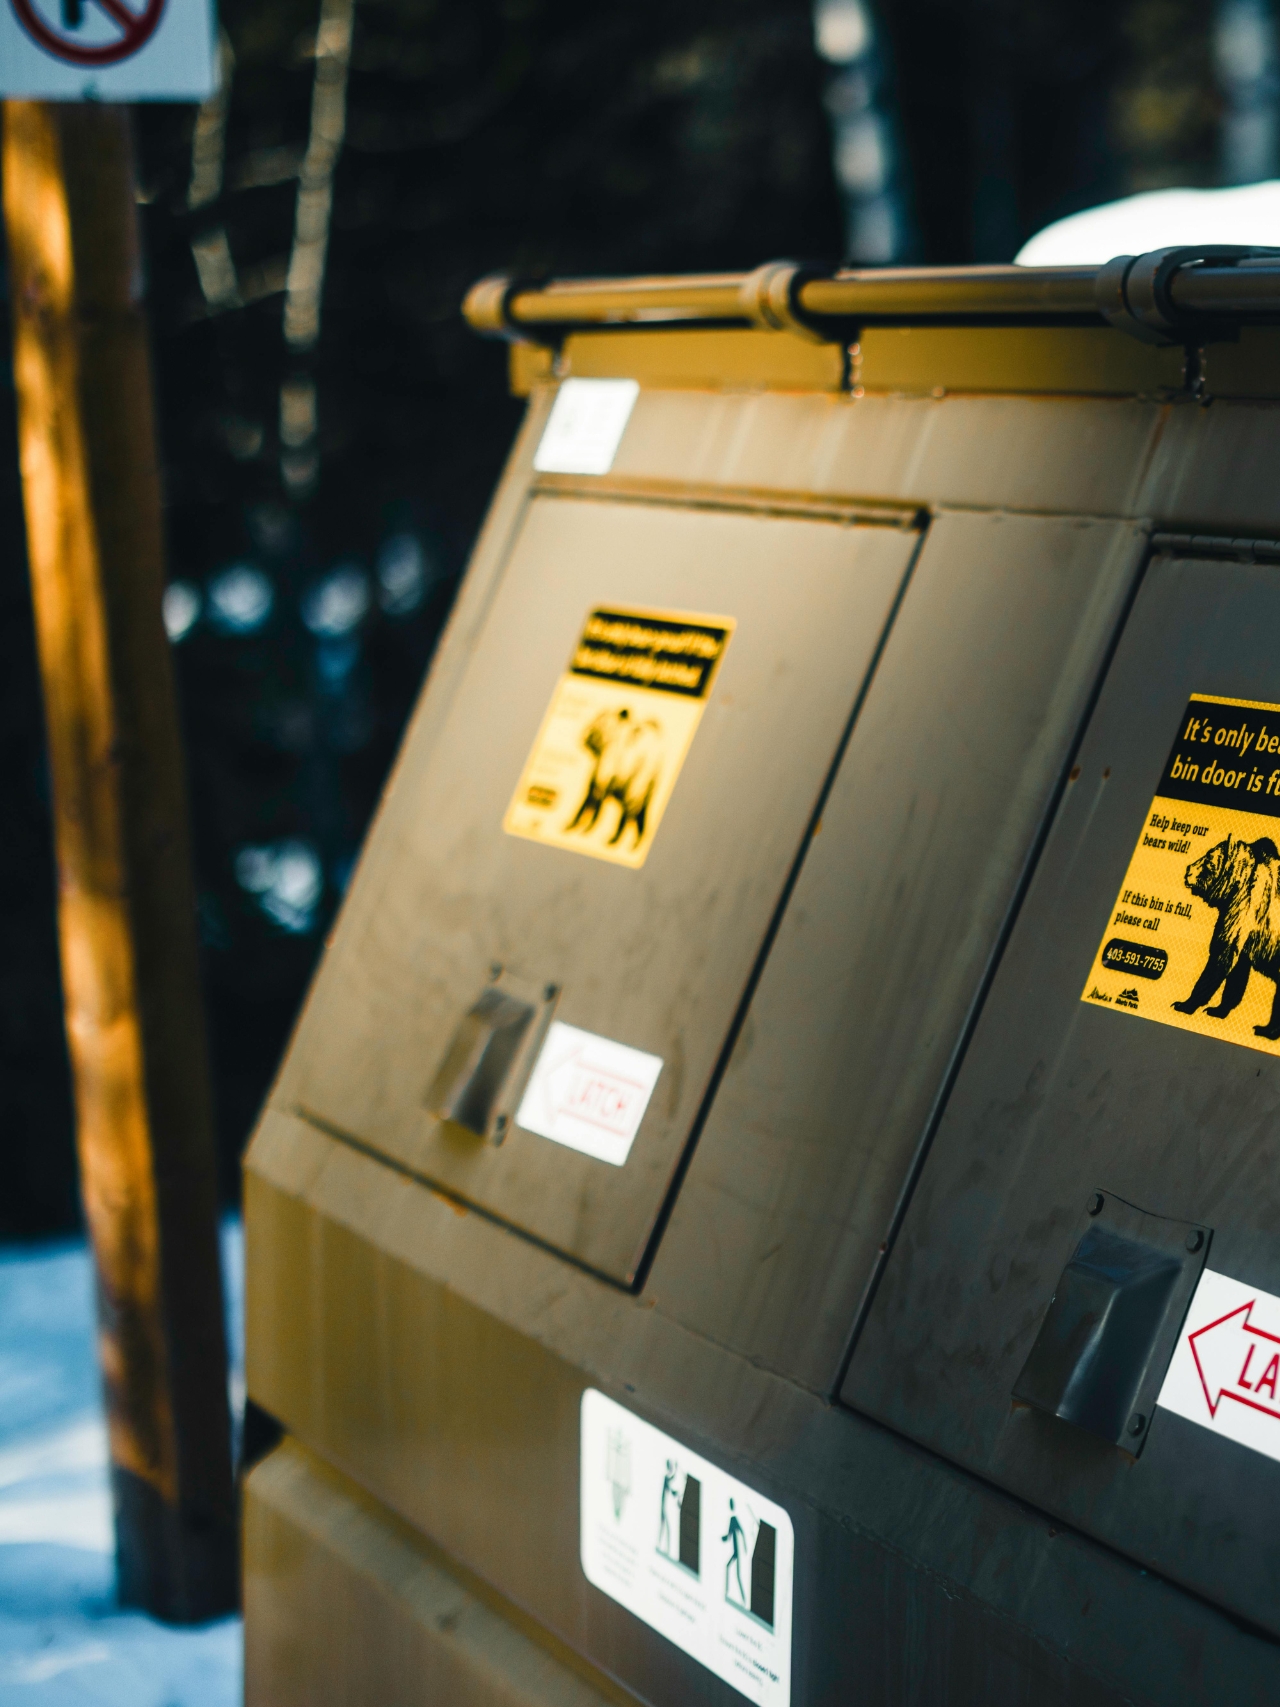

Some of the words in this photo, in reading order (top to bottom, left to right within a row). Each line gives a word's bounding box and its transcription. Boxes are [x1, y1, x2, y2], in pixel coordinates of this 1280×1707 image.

[1183, 717, 1212, 743] It's
[1214, 725, 1254, 757] only
[1170, 754, 1200, 782] bin
[1201, 759, 1246, 789] door
[1246, 766, 1264, 793] is
[1149, 814, 1170, 831] Help
[1170, 818, 1193, 837] keep
[1192, 825, 1210, 837] our
[1142, 833, 1167, 850] bears
[1167, 838, 1191, 854] wild!
[1121, 890, 1134, 904] If
[1128, 892, 1149, 908] this
[1149, 896, 1165, 911] bin
[1165, 899, 1174, 912] is
[1174, 901, 1193, 919] full,
[1113, 910, 1142, 926] please
[1143, 917, 1160, 931] call
[1106, 947, 1166, 972] 403-591-7755
